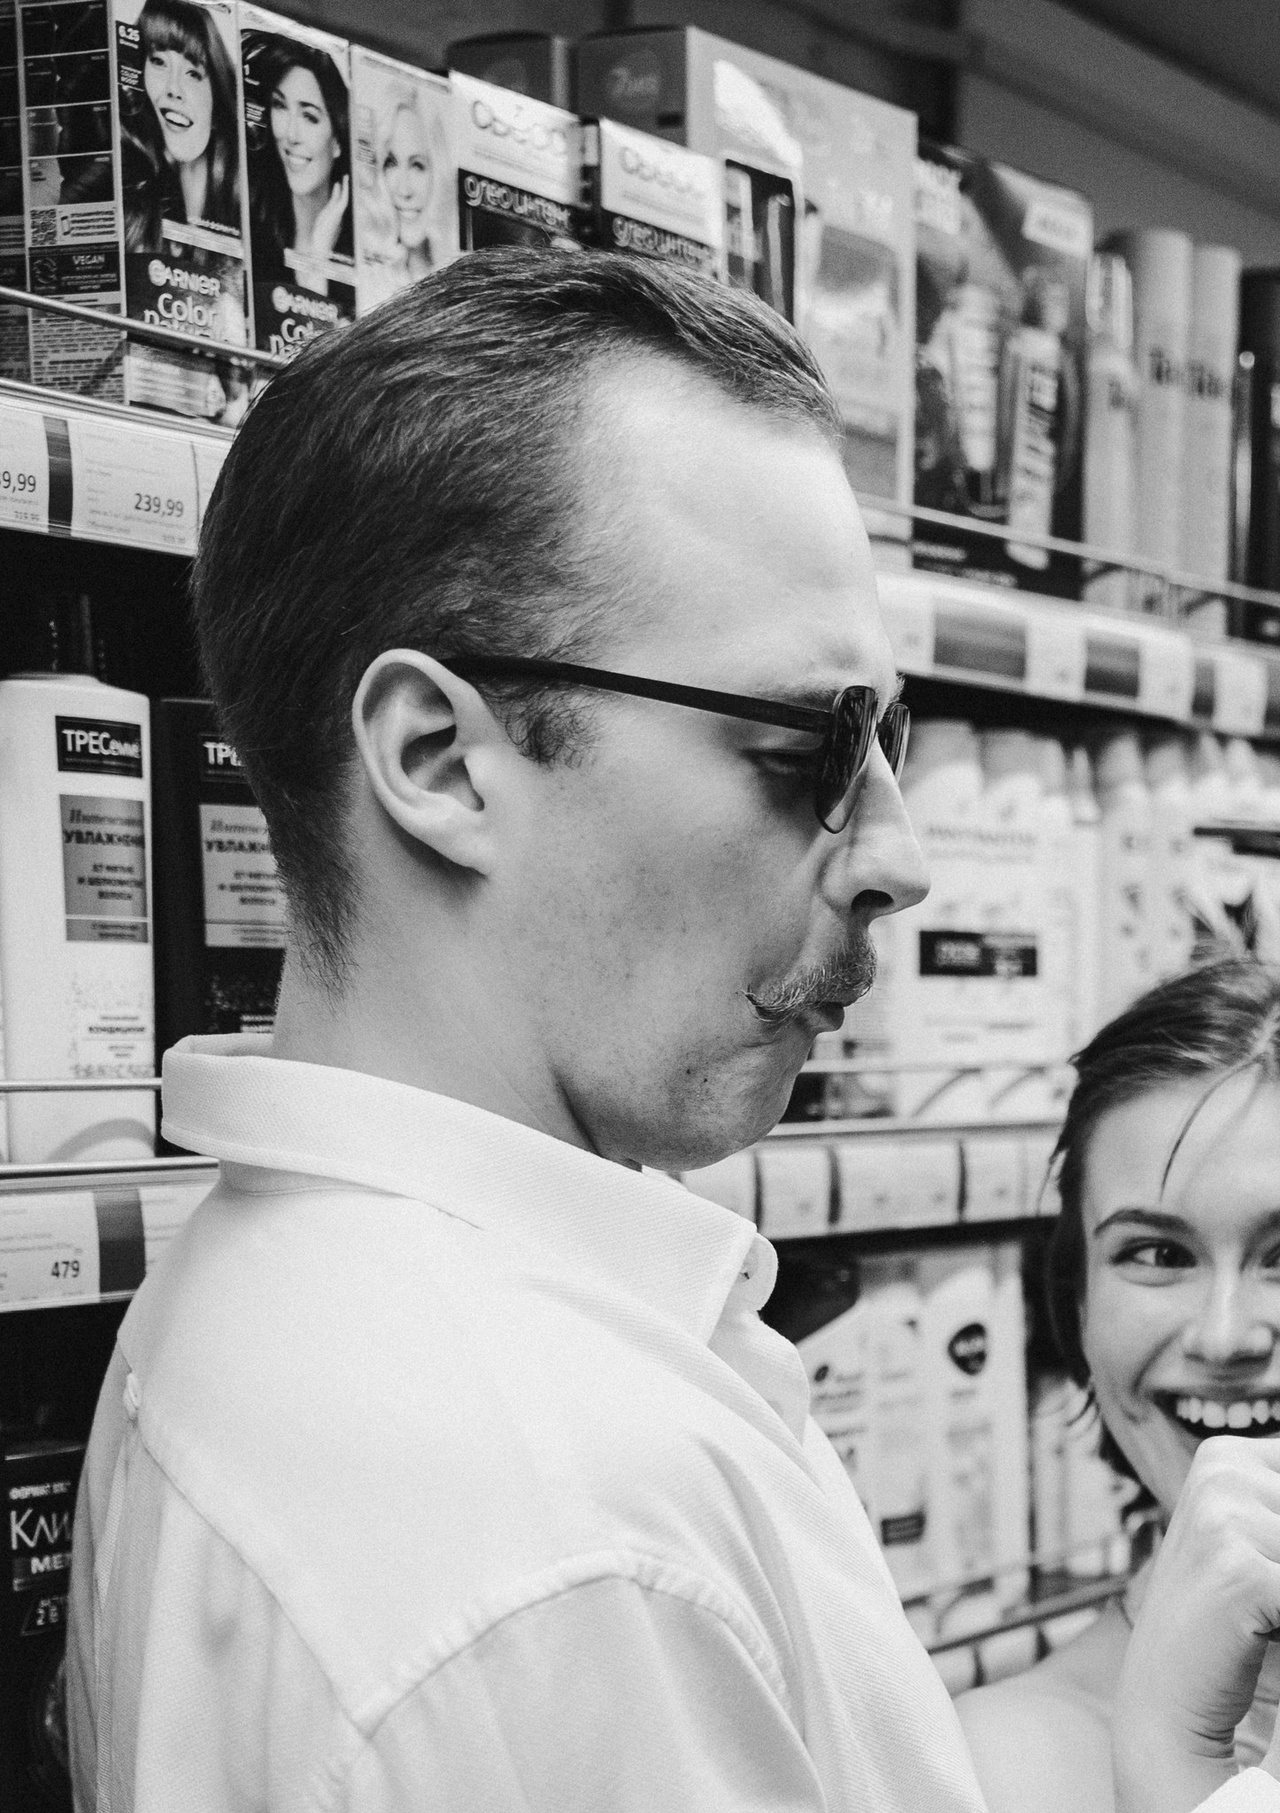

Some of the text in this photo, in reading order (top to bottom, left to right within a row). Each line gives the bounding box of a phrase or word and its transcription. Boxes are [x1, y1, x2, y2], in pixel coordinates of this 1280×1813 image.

[148, 258, 221, 298] GARNIER
[157, 292, 218, 327] Color
[0, 470, 37, 494] 9,99
[134, 482, 185, 519] 239,99
[50, 1259, 81, 1279] 479
